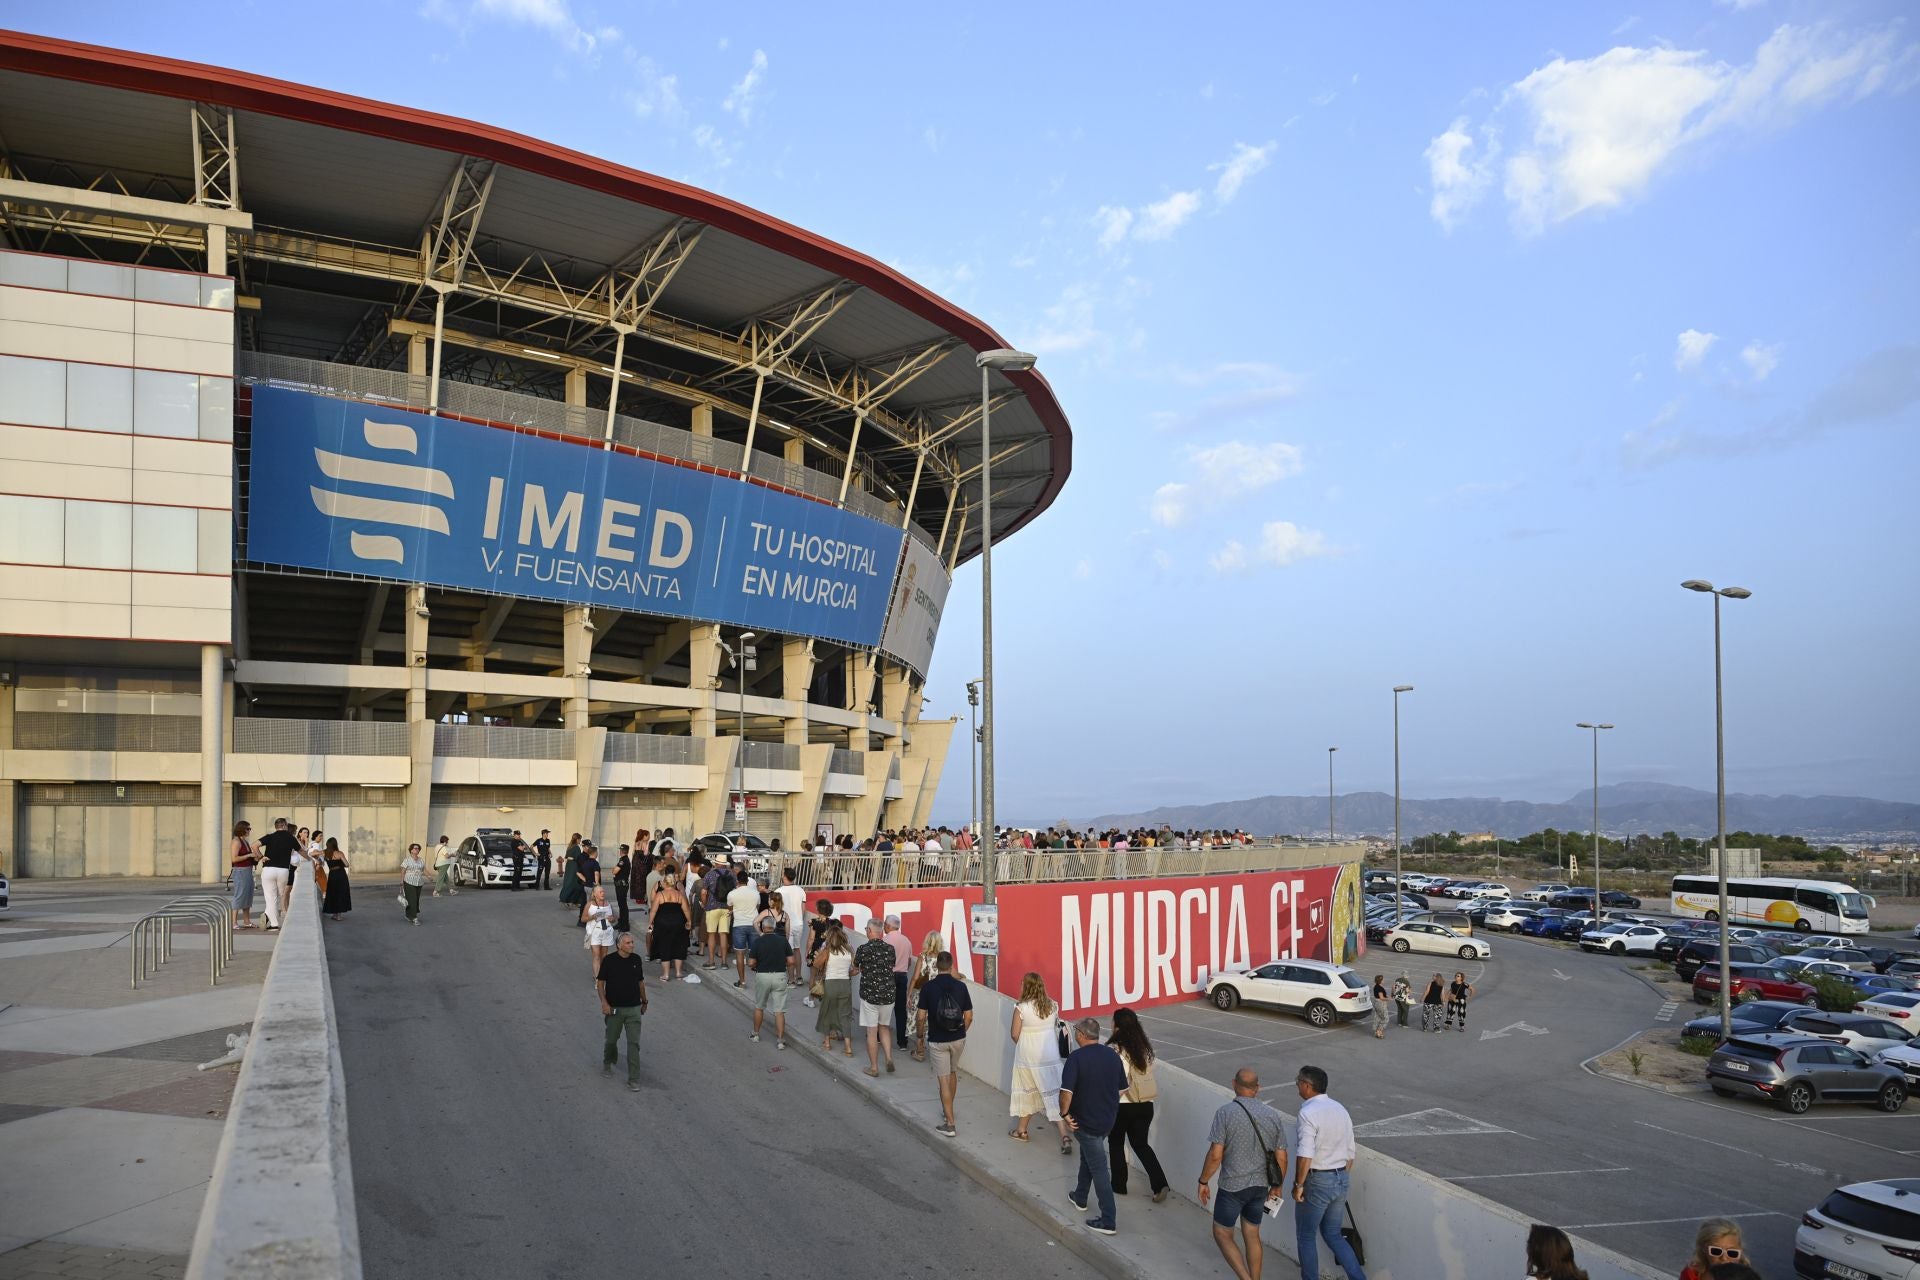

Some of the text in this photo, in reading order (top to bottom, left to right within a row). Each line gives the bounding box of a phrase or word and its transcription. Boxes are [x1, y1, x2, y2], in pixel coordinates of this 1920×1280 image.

[483, 476, 693, 569] IMED
[751, 522, 878, 576] TU HOSPITAL
[481, 546, 682, 600] V. FUENSANTA
[742, 564, 857, 610] EN MURCIA
[1061, 884, 1250, 1011] MURCIA
[1270, 880, 1305, 961] CF
